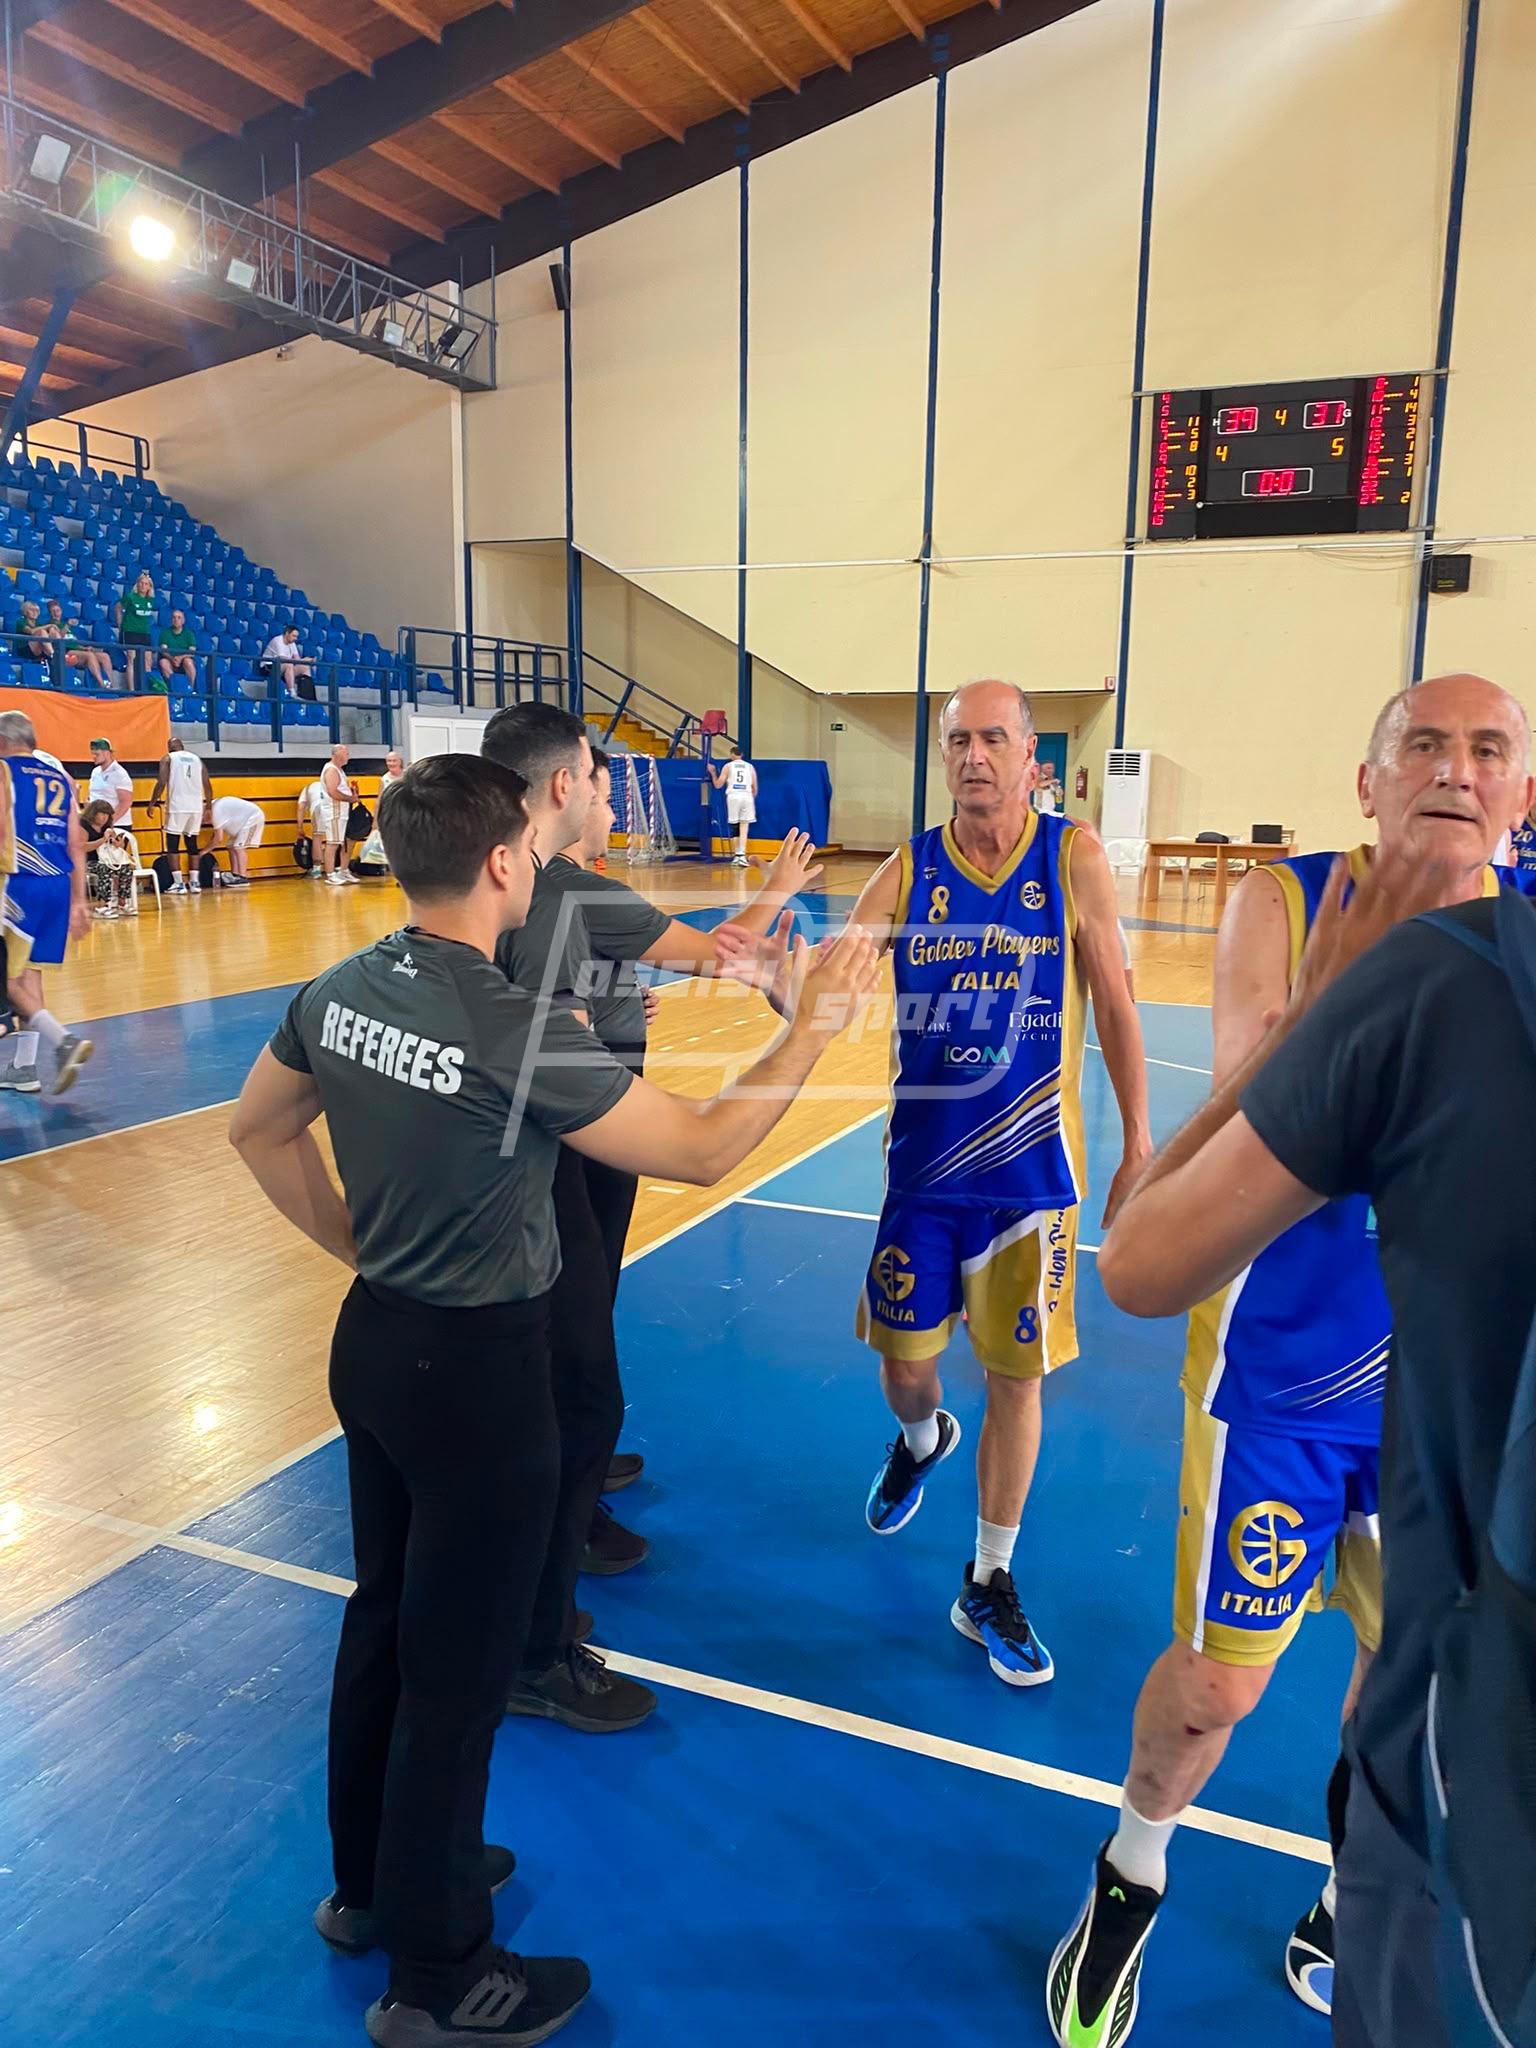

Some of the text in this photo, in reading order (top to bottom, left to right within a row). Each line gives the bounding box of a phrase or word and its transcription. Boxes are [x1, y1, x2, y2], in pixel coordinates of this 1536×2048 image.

[1414, 376, 1420, 387] 1
[1410, 389, 1419, 399] 4
[1343, 408, 1352, 418] G
[1404, 402, 1418, 413] 14
[1226, 409, 1256, 432] 39
[1275, 409, 1287, 426] 4
[1311, 404, 1344, 425] 31
[1407, 415, 1416, 426] 3
[1187, 416, 1200, 427] 11
[1212, 418, 1220, 427] H
[1190, 428, 1199, 439] 5
[1406, 428, 1415, 439] 2
[1331, 437, 1344, 456] 5
[1409, 440, 1415, 451] 1
[1215, 445, 1228, 462] 4
[1404, 453, 1413, 465] 3
[1185, 465, 1197, 476] 10
[1407, 466, 1413, 477] 1
[1187, 477, 1196, 488] 2
[1187, 489, 1196, 500] 3
[1400, 491, 1411, 503] 2
[736, 770, 744, 783] 5
[33, 777, 66, 816] 12
[928, 885, 950, 924] 8
[981, 923, 1060, 966] Players
[951, 971, 1020, 991] TALIA
[1009, 1011, 1062, 1033] Egadi
[320, 1001, 465, 1095] REFEREES
[1014, 1306, 1038, 1344] 8
[1220, 1591, 1293, 1617] ITALIA
